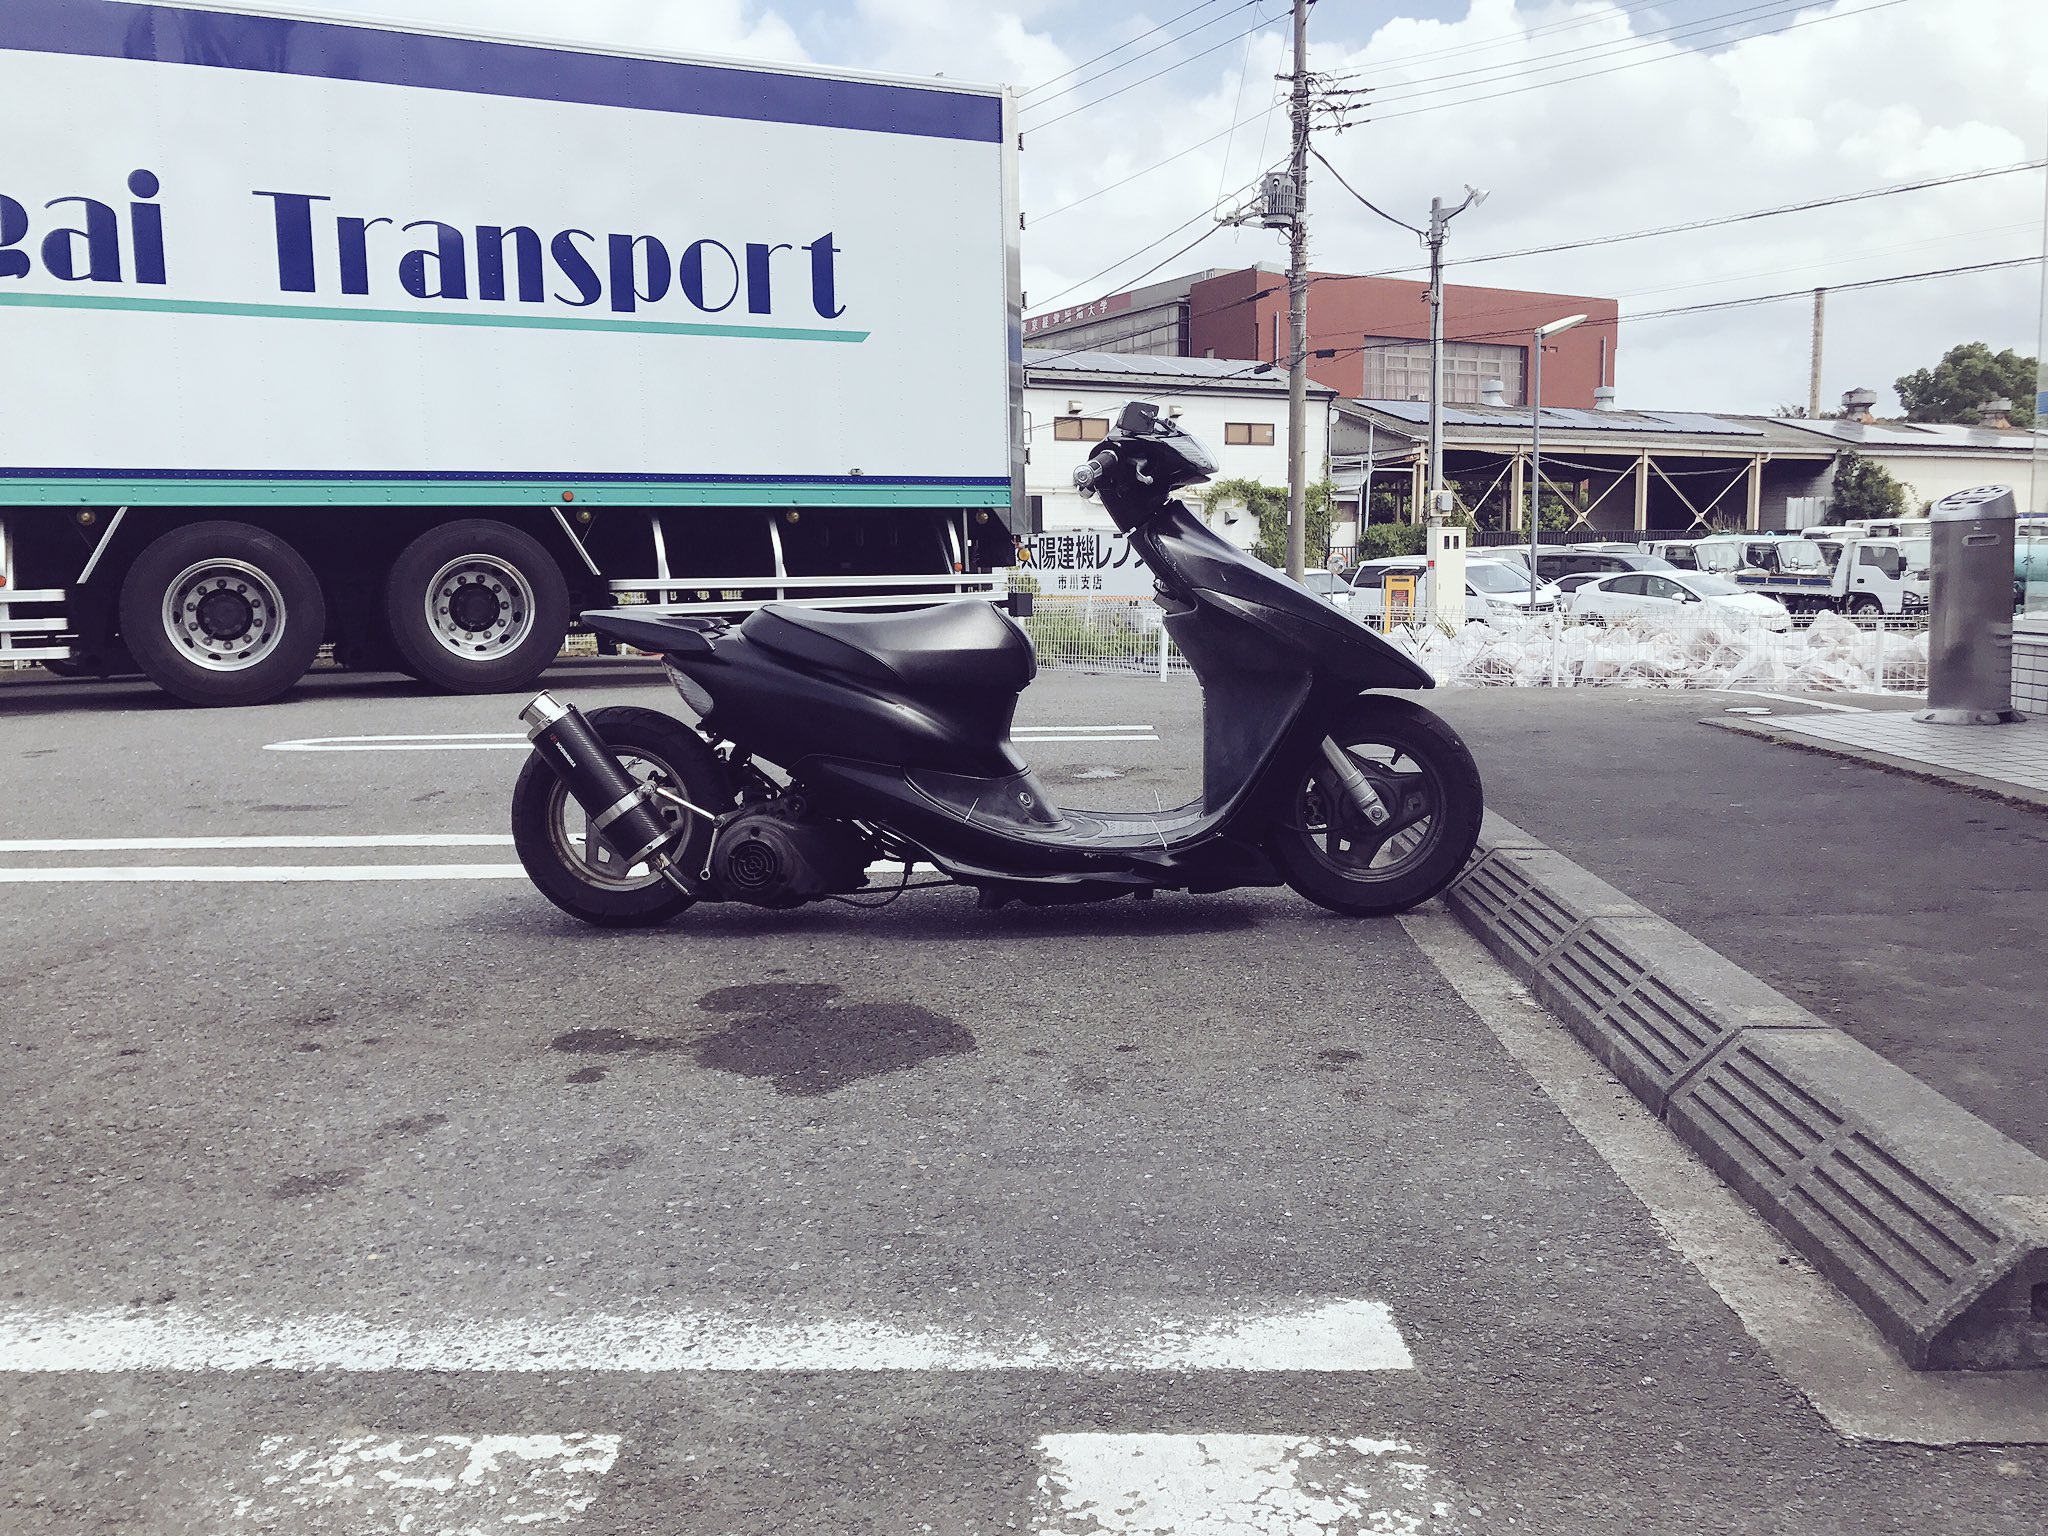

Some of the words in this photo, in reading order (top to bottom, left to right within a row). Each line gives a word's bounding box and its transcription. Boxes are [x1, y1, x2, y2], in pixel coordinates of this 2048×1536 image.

[252, 190, 847, 320] Transport
[1019, 533, 1145, 570] 太陽建機レン
[1057, 573, 1102, 591] 市川支店
